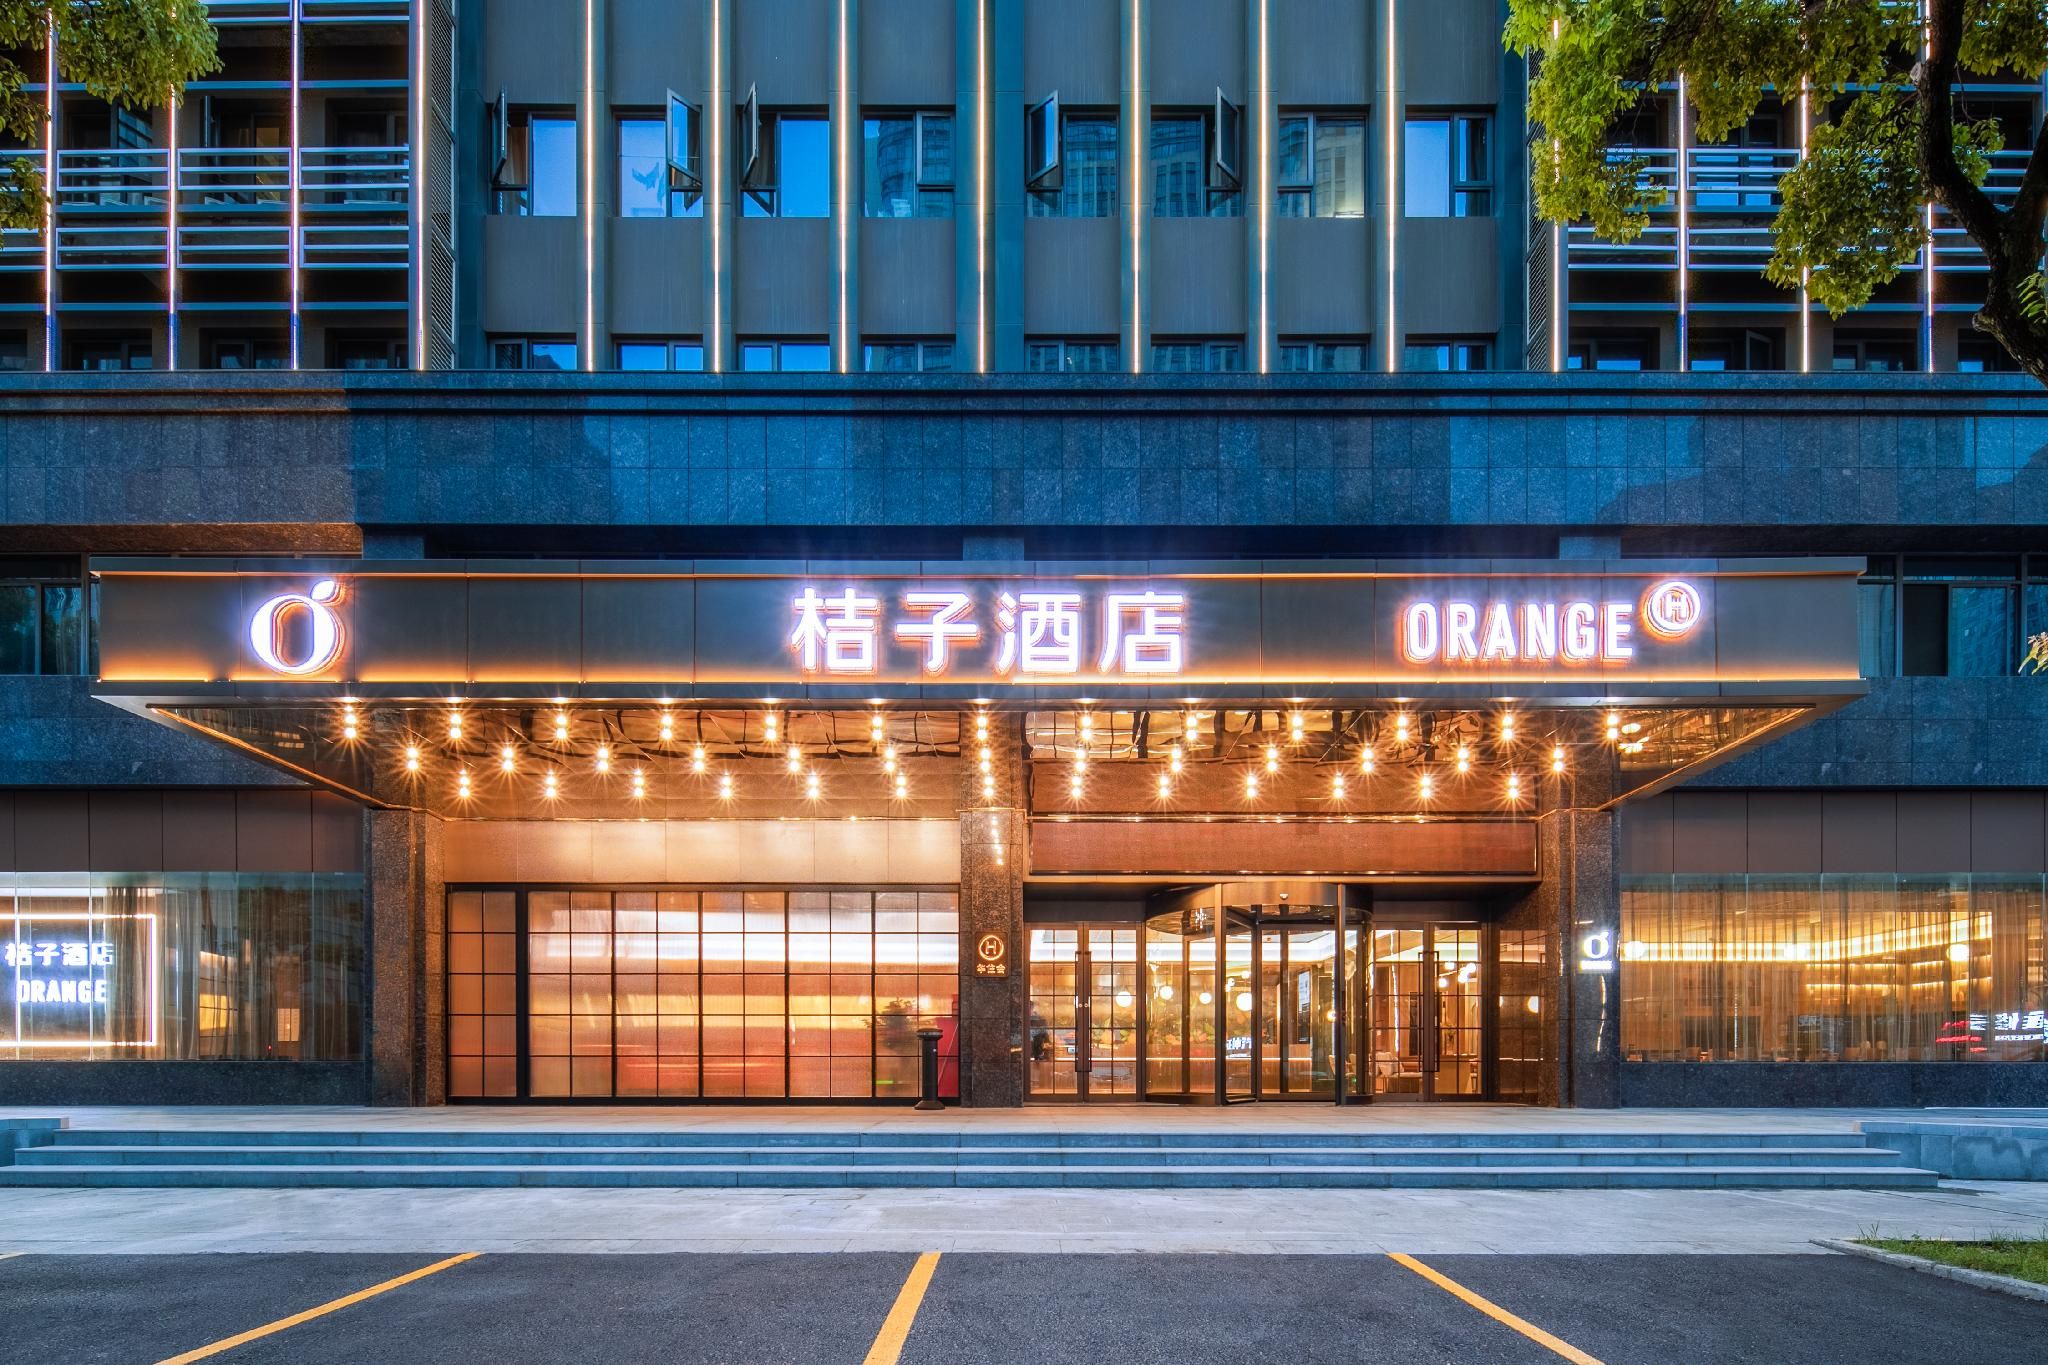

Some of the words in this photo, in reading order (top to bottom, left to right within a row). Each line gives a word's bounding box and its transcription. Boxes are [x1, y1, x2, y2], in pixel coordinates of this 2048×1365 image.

[791, 587, 1185, 673] 桔子酒店
[1405, 601, 1634, 661] ORANGE
[4, 942, 114, 967] 桔子酒店
[16, 979, 108, 1003] ORANGE
